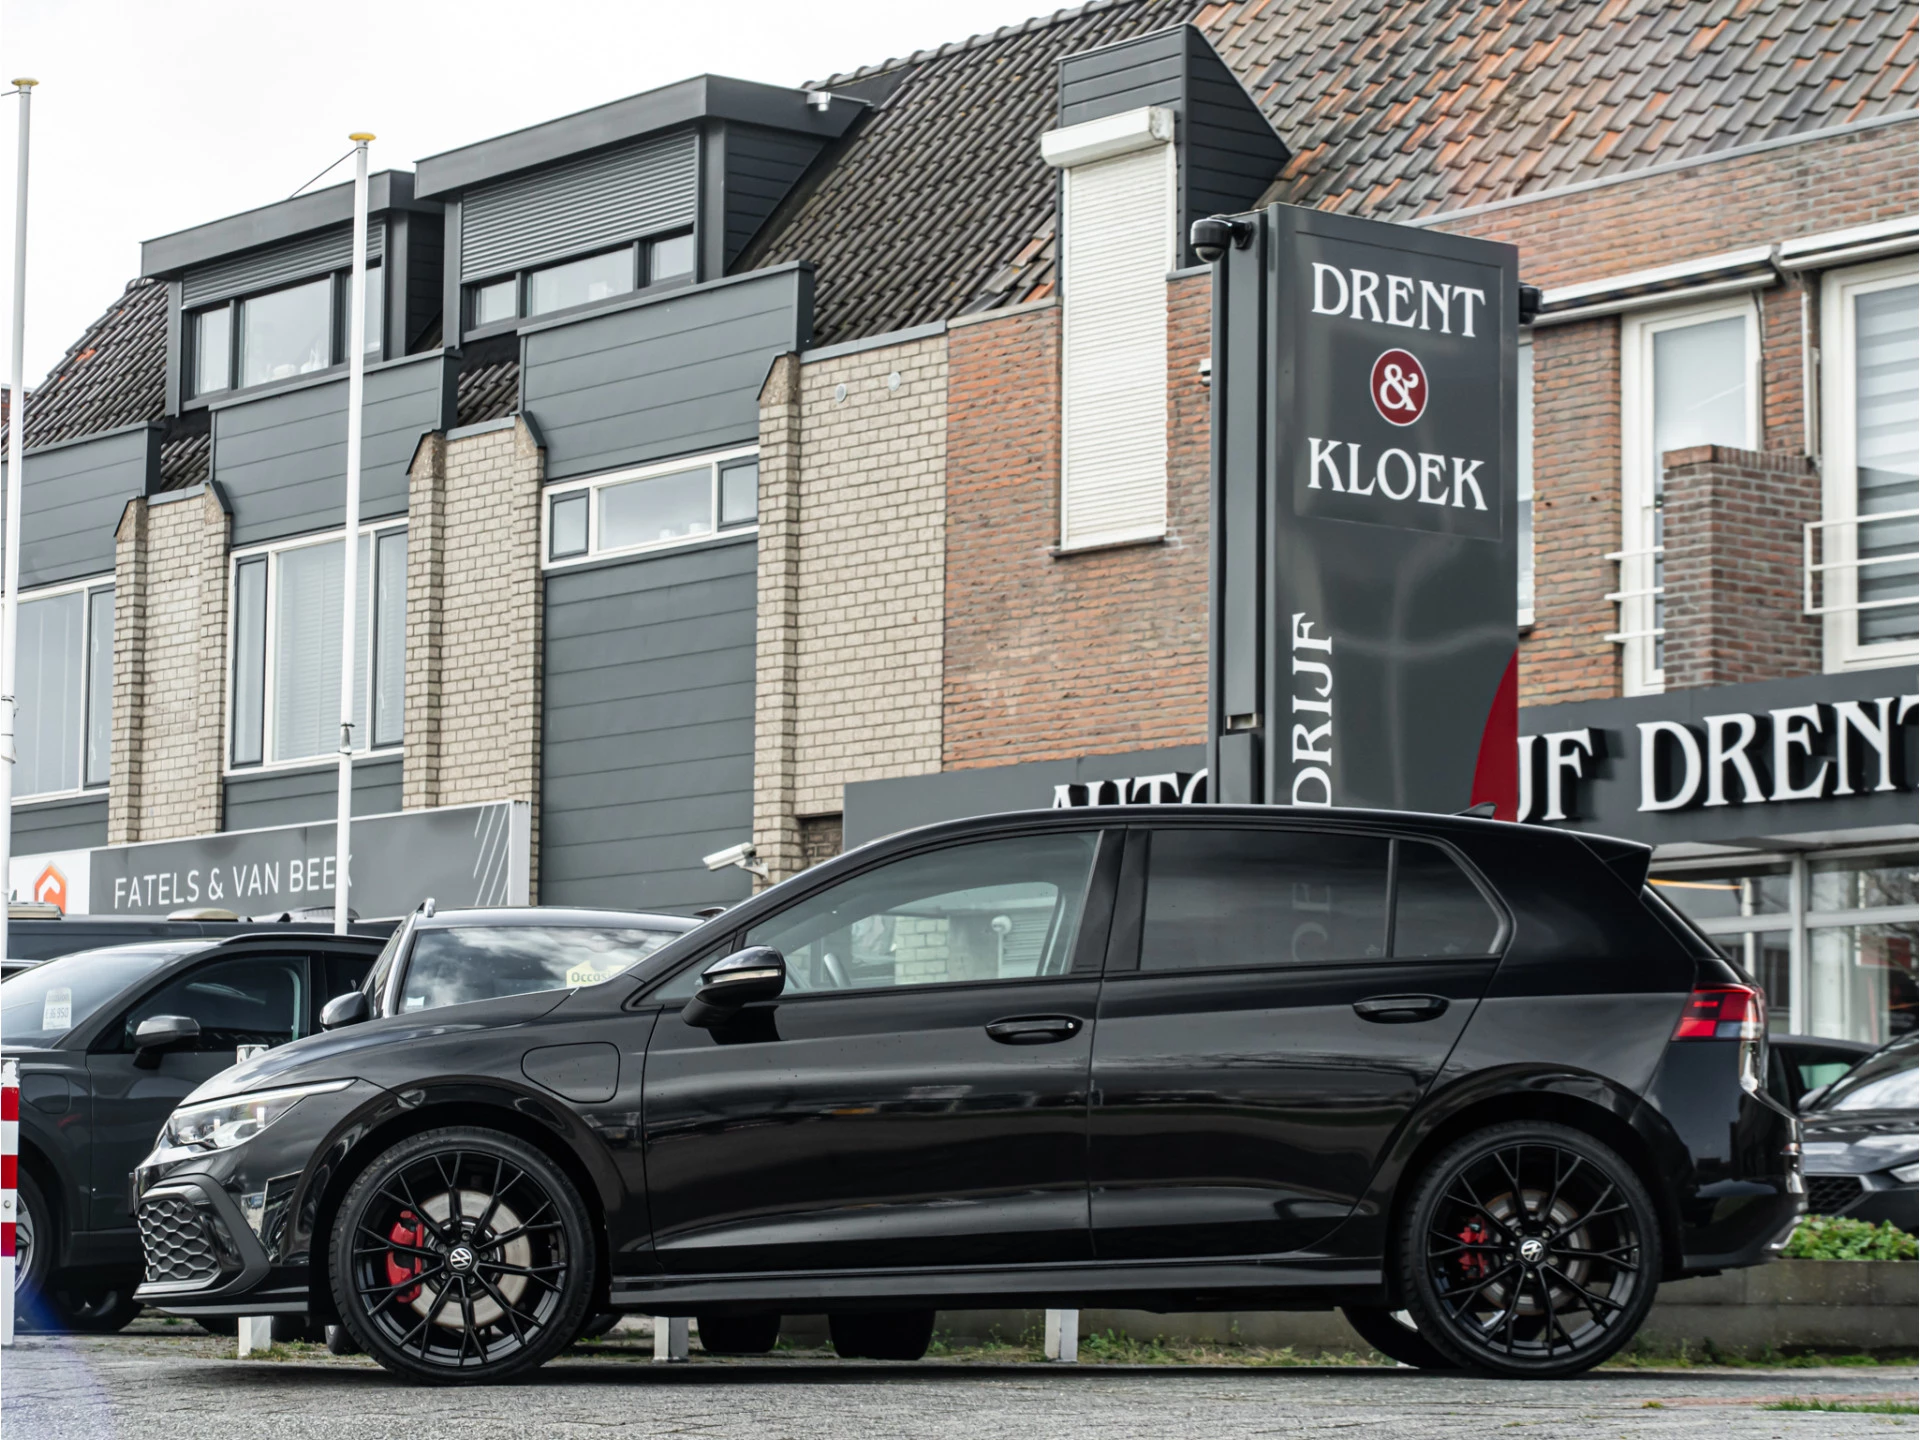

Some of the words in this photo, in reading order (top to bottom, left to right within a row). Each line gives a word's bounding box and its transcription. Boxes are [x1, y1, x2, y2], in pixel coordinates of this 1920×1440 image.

[1311, 262, 1486, 337] DRENT
[1379, 363, 1419, 411] &
[1307, 437, 1488, 511] KLOEK
[114, 870, 200, 909] FATELS
[207, 867, 224, 901] &
[232, 861, 280, 898] VAN
